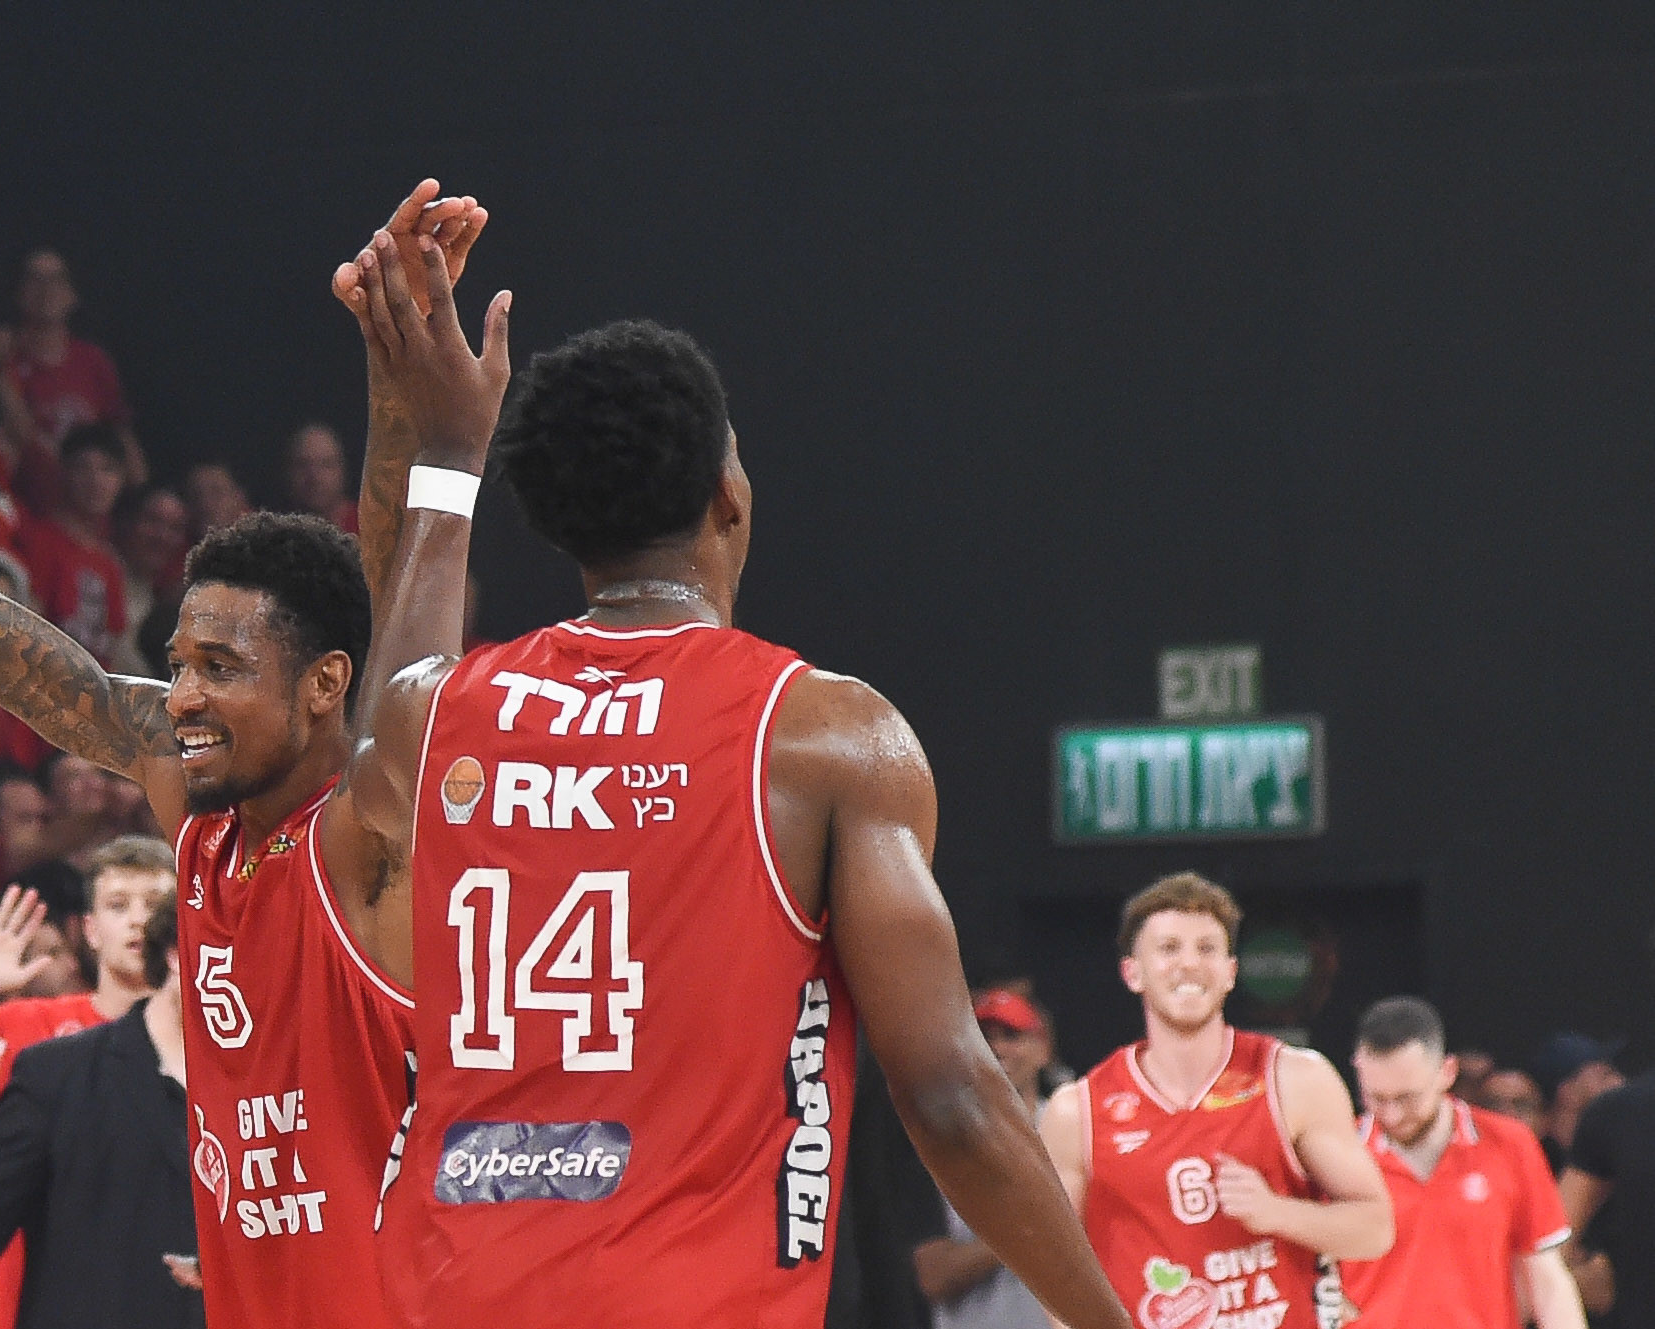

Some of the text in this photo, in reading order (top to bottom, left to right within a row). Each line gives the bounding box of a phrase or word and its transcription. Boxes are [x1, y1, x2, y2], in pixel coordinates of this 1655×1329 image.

[490, 670, 664, 735] הורד
[492, 761, 615, 829] RK
[631, 797, 675, 829] כץ
[195, 943, 253, 1049] 5
[447, 867, 644, 1072] 14
[786, 977, 832, 1260] HAPOEL
[241, 1146, 279, 1191] IT
[445, 1147, 621, 1187] CyberSafe
[1166, 1157, 1218, 1225] 6
[1204, 1240, 1278, 1282] GIVE
[1215, 1279, 1248, 1312] IT
[1253, 1272, 1280, 1303] A
